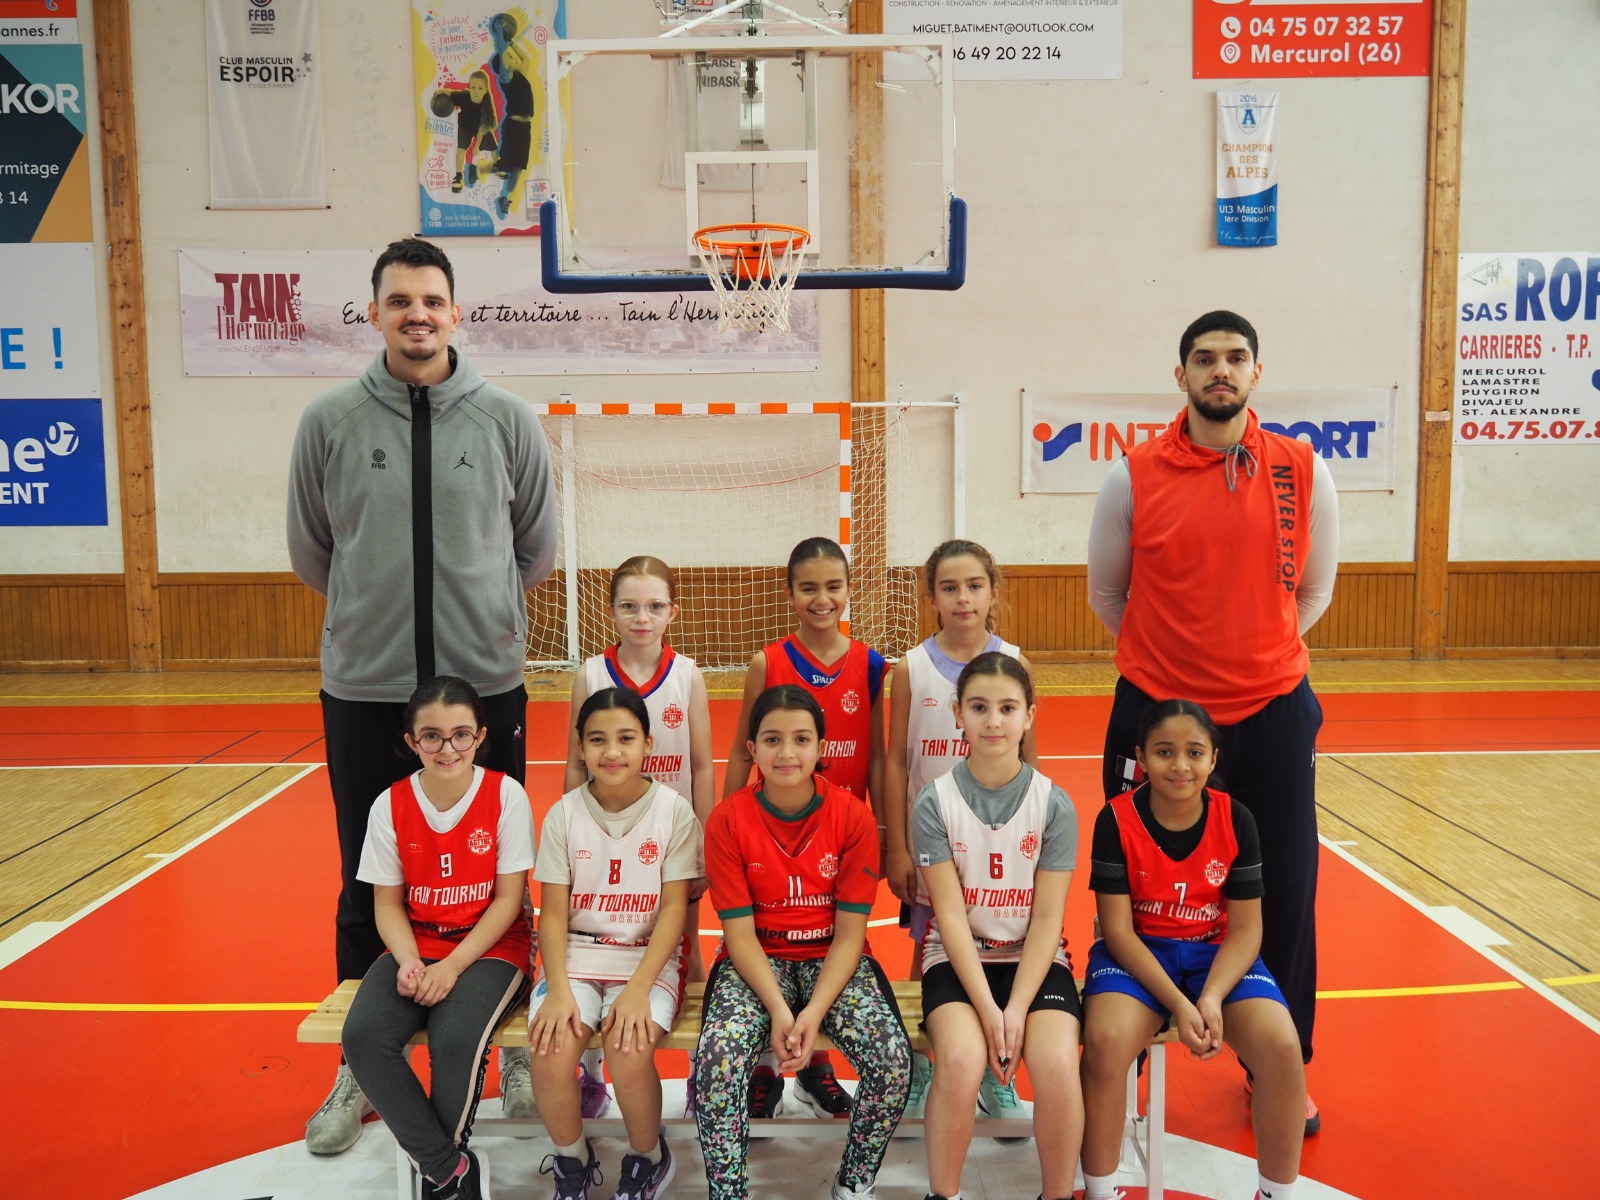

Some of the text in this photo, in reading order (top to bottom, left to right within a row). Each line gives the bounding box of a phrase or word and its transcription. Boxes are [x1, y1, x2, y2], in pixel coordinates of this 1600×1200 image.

[888, 0, 940, 8] CONSTRUCTION
[248, 9, 276, 21] FFBB
[1, 23, 60, 37] annes.fr
[912, 23, 1094, 34] MIGUET.BATIMENT@OUTLOOK.COM
[1250, 16, 1403, 37] 04 75 07 32 57
[953, 46, 1062, 60] 6 49 20 22 14
[1251, 42, 1401, 65] Mercurol (26)
[220, 57, 293, 65] CLUB MASCULIN
[220, 66, 295, 83] ESPOIR
[0, 83, 82, 115] KOR
[1222, 143, 1273, 153] CHAMPION
[1239, 155, 1259, 164] DES
[1226, 166, 1269, 179] ALPES
[9, 191, 29, 204] 14
[1219, 204, 1275, 214] U13 Masculin
[1224, 214, 1269, 223] 1ère Division
[214, 273, 301, 323] TAIN
[471, 304, 494, 322] et
[494, 301, 582, 322] territoire
[619, 301, 662, 321] Tain
[1461, 302, 1508, 322] SAS
[216, 305, 307, 346] l'Hermitage
[1460, 334, 1542, 360] CARRIERES
[1566, 333, 1592, 358] T.P.
[1462, 368, 1547, 376] MERCUROL
[1462, 378, 1540, 386] LAMASTRE
[1462, 388, 1540, 396] PUYGIRON
[1462, 398, 1524, 406] DIVAJEU
[1490, 407, 1581, 416] ALEXANDRE
[371, 462, 386, 470] FFBB
[1270, 465, 1296, 593] NEVER STOP
[922, 740, 949, 757] TAIN
[440, 853, 453, 878] 9
[609, 859, 621, 885] 8
[990, 853, 1003, 879] 6
[433, 880, 494, 906] TOURNON
[788, 875, 802, 898] 11
[980, 888, 1034, 907] TOURNO
[1174, 882, 1187, 906] 7
[598, 893, 658, 912] TOURNON
[609, 914, 655, 923] BASKET
[994, 908, 1031, 918] BASK
